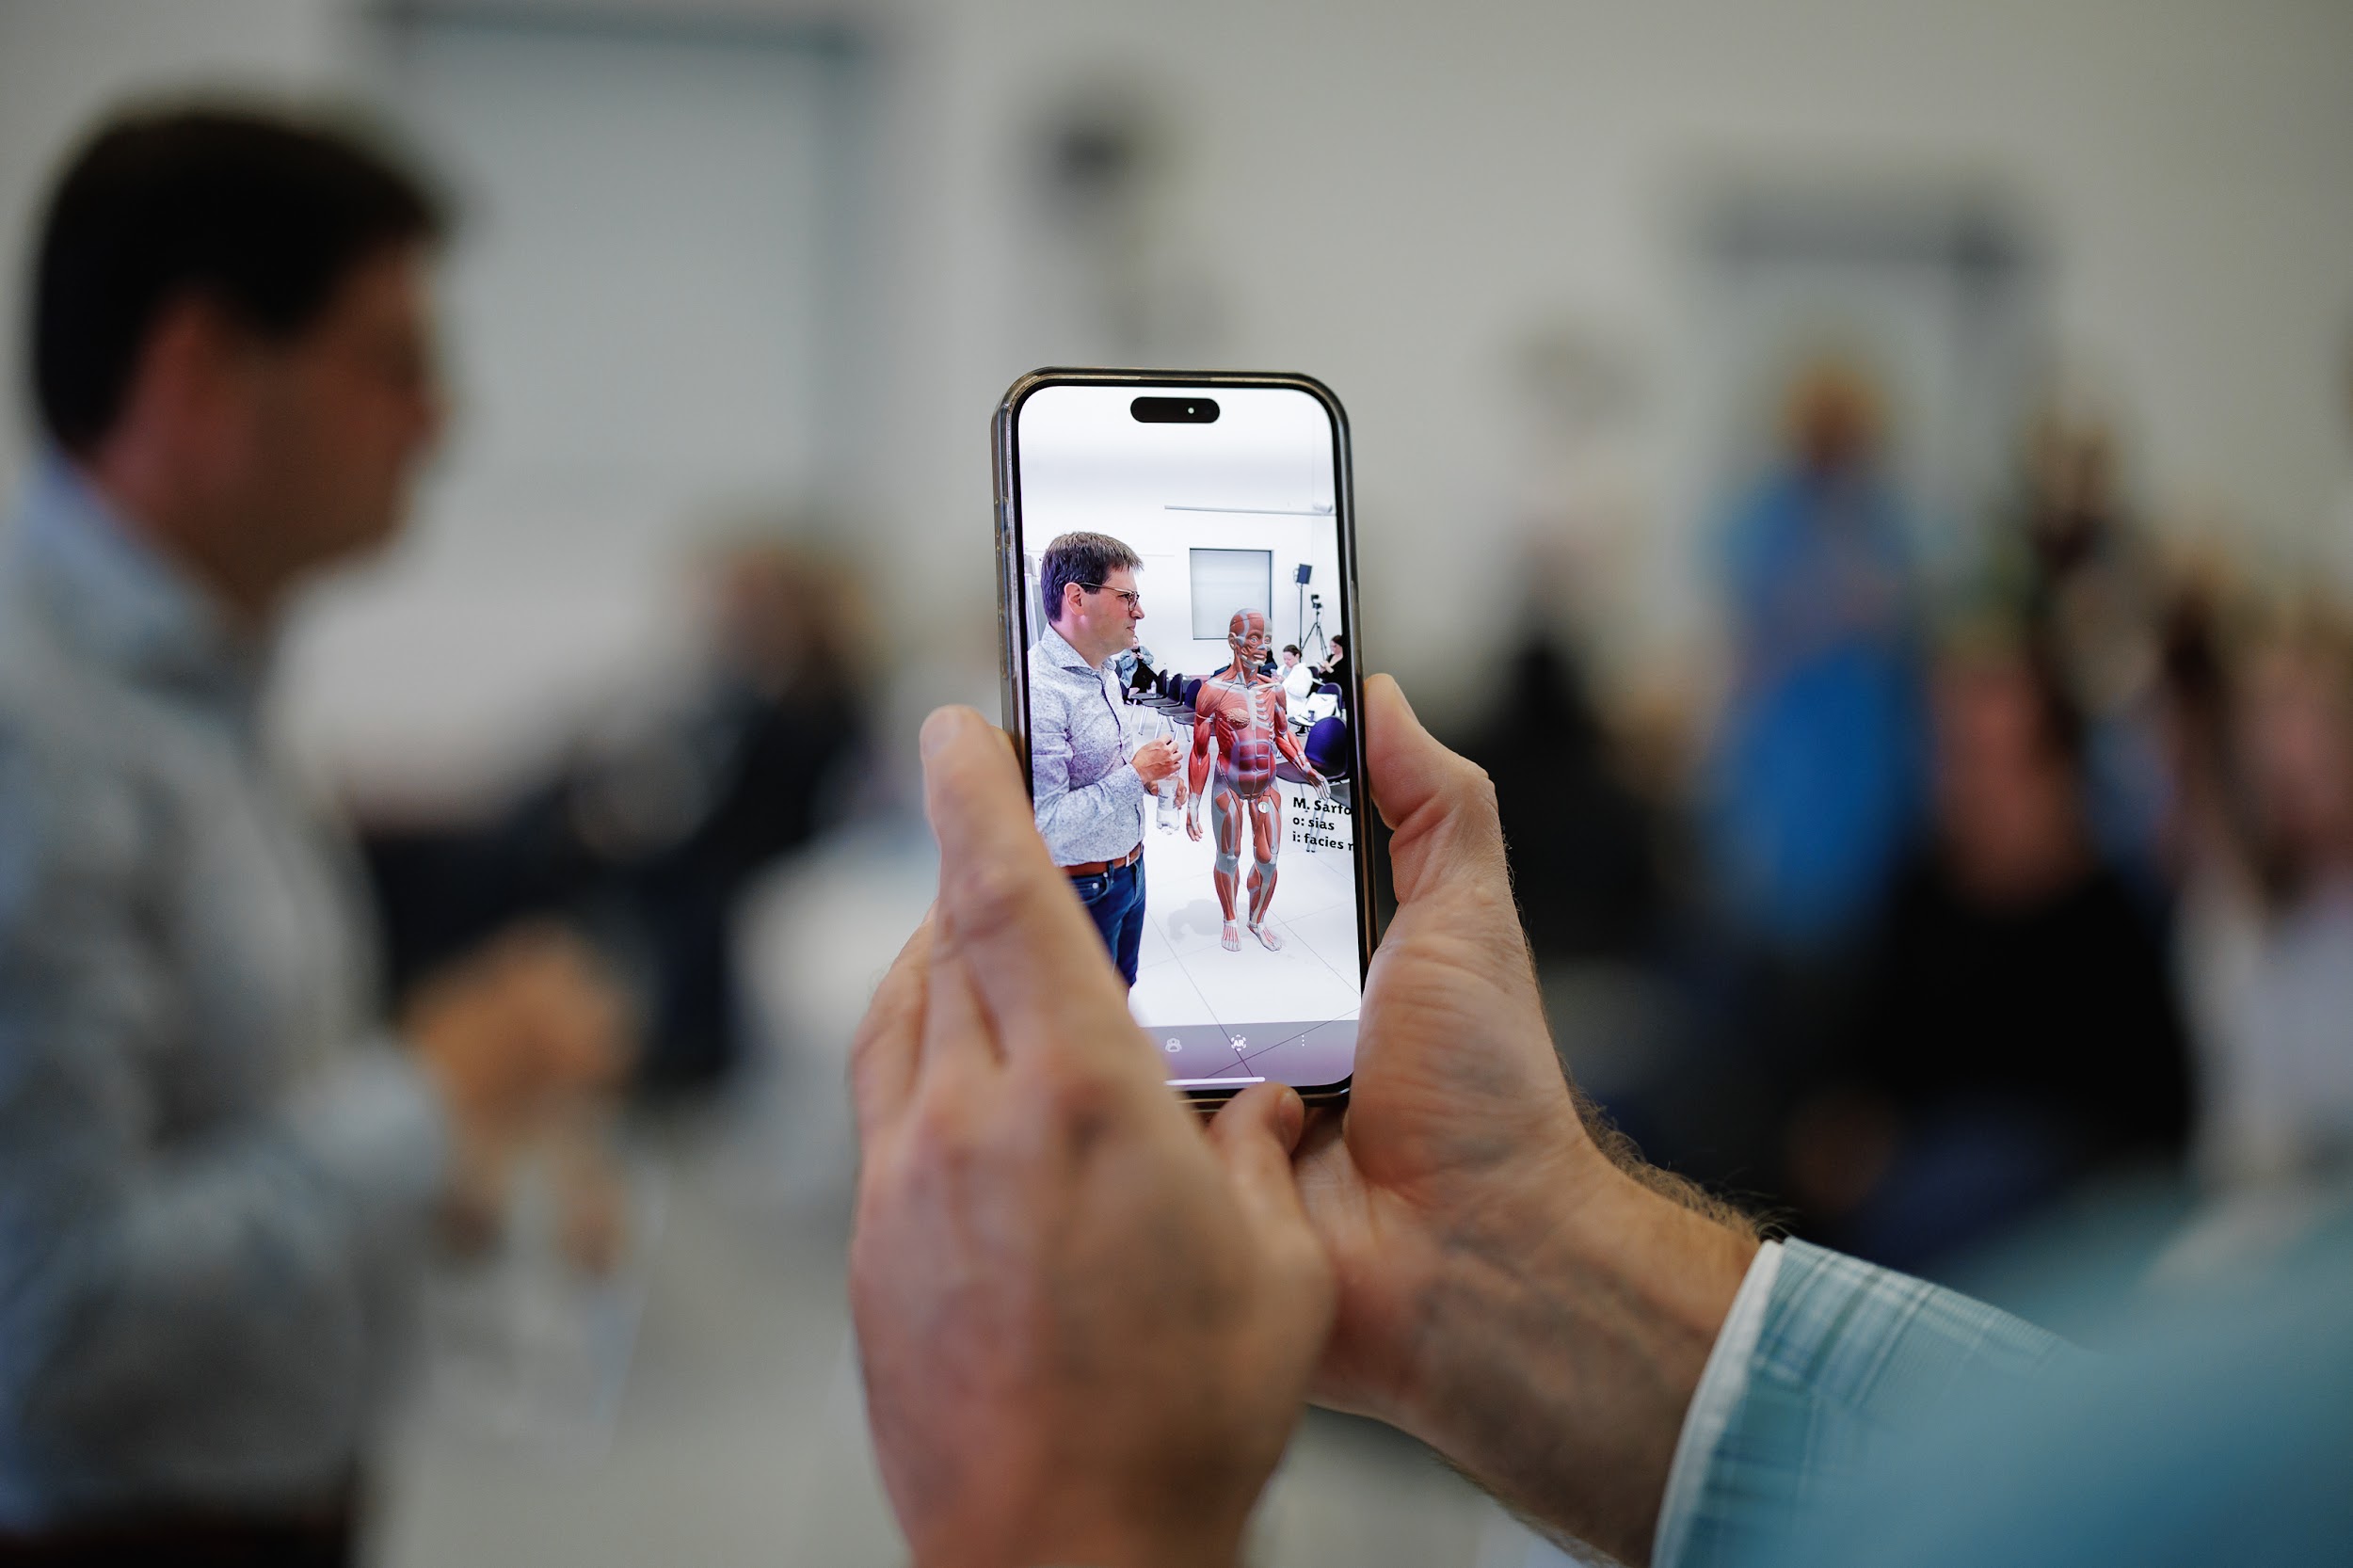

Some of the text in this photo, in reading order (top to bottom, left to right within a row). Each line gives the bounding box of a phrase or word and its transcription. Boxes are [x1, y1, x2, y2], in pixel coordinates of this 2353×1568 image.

[1293, 797, 1310, 810] M.
[1292, 817, 1335, 830] o: sias
[1292, 831, 1301, 842] i:
[1304, 833, 1344, 849] facies
